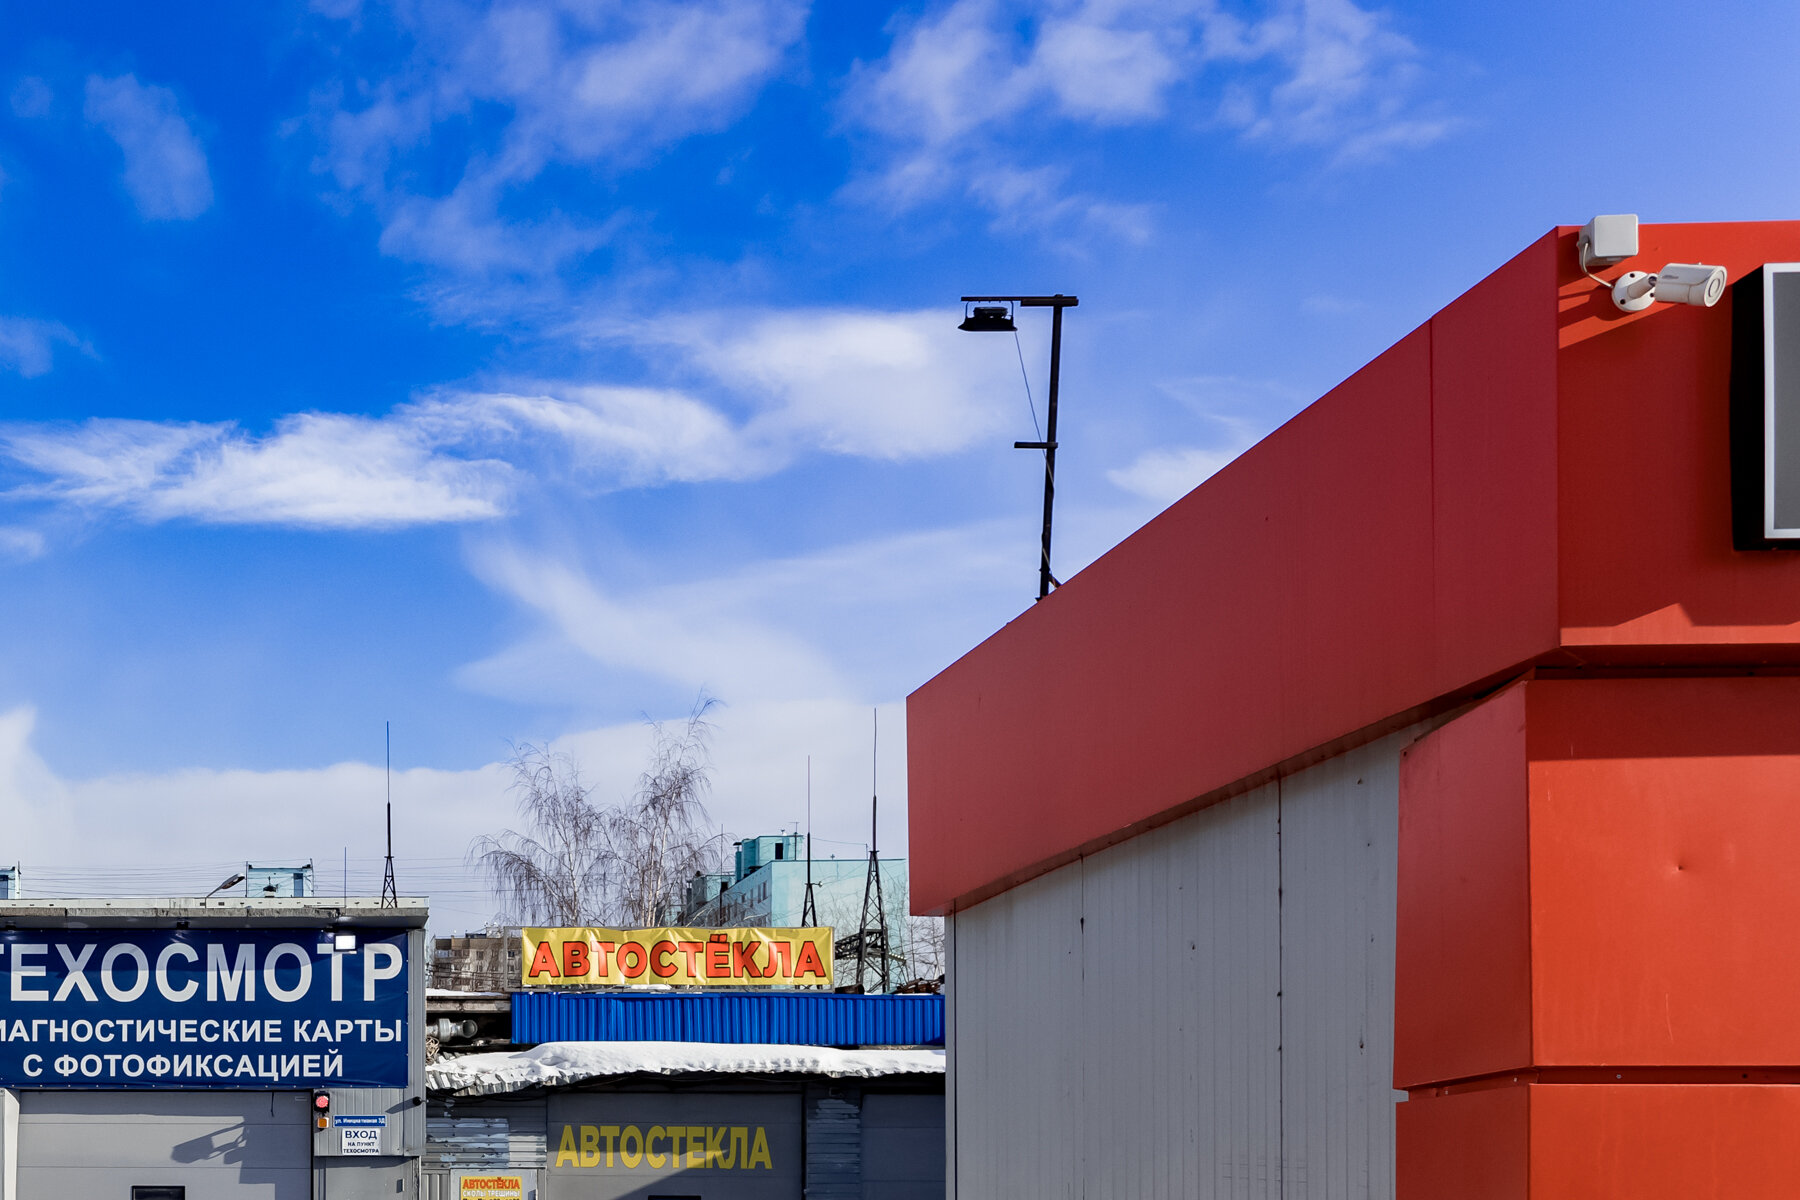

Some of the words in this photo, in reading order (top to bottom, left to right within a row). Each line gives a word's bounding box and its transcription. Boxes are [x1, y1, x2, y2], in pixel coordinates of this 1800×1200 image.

[528, 933, 827, 979] АВТОСТЁКЛА
[293, 1019, 402, 1043] КАРТЫ
[22, 1053, 43, 1078] С
[53, 1049, 343, 1082] ФОТОФИКСАЦИЕЙ
[345, 1131, 377, 1139] ВХОД
[554, 1124, 773, 1169] АВТОСТЕКЛА
[462, 1177, 520, 1189] АВТОСТЁКЛА
